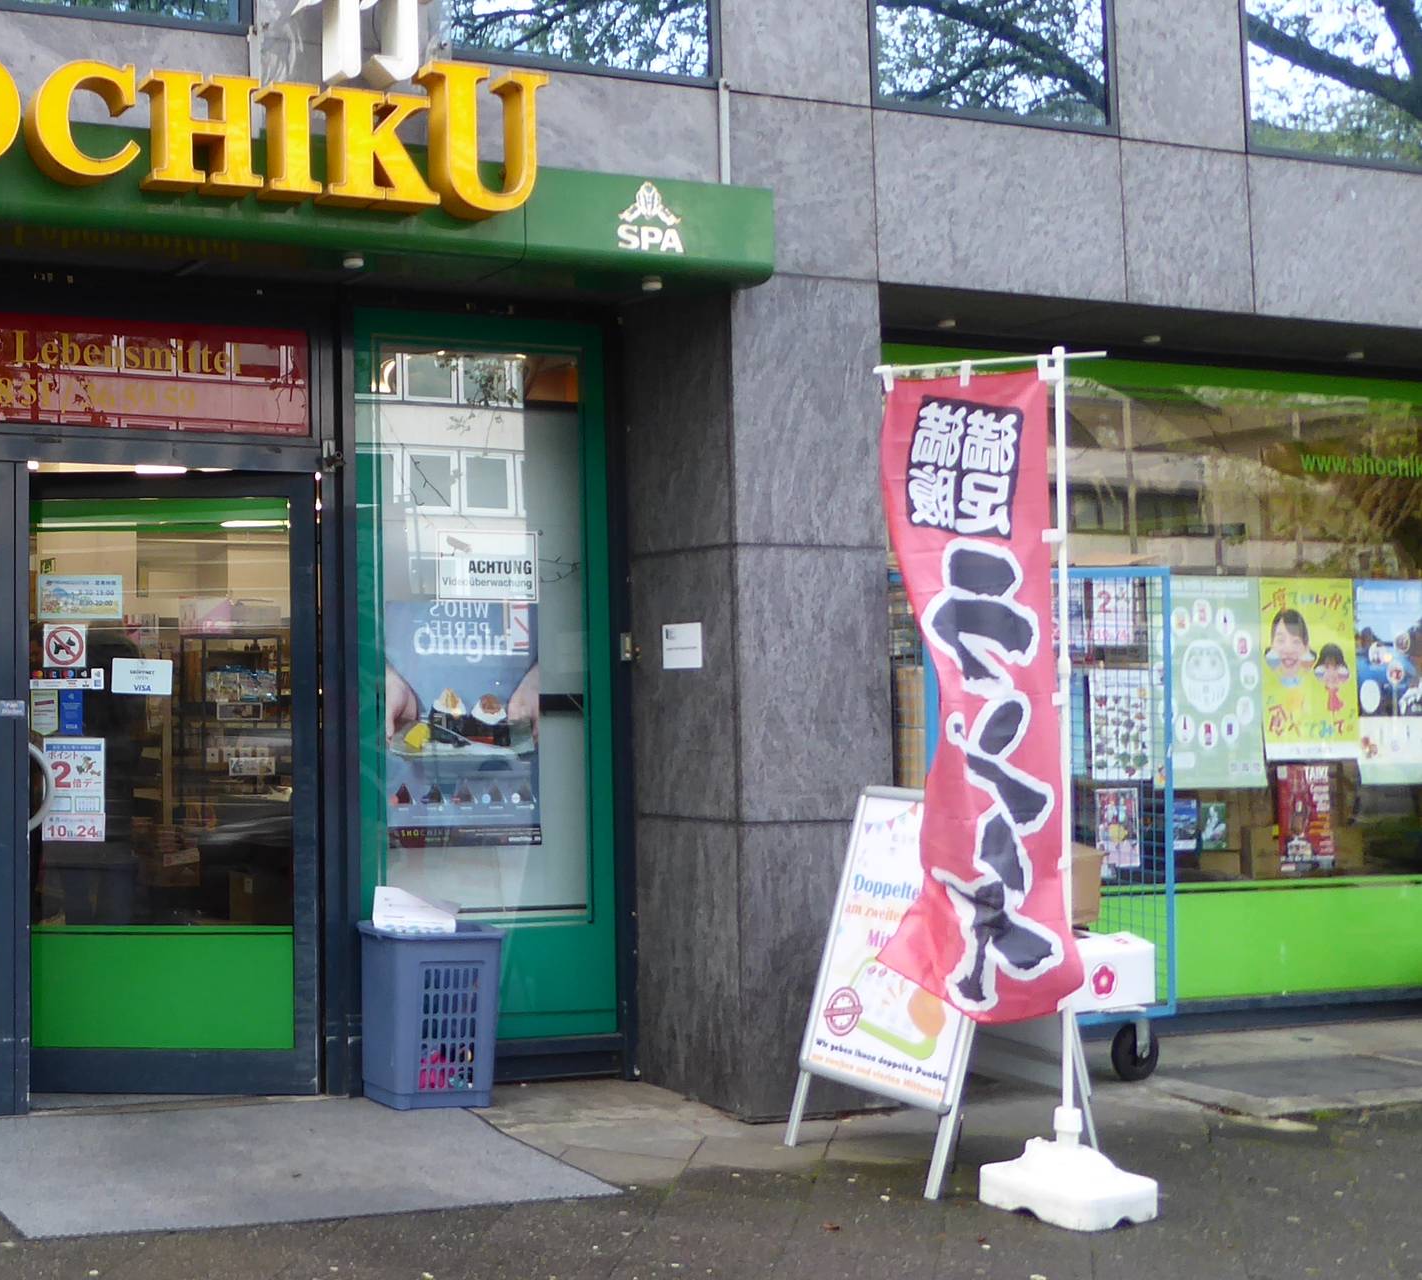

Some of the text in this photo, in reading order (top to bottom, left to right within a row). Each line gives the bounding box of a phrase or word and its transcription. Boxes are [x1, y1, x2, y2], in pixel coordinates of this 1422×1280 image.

[617, 224, 684, 254] SPA
[13, 329, 242, 374] Lebensmittel
[468, 560, 532, 575] ACHTUNG
[134, 684, 152, 692] VISA
[853, 873, 920, 900] Doppelte
